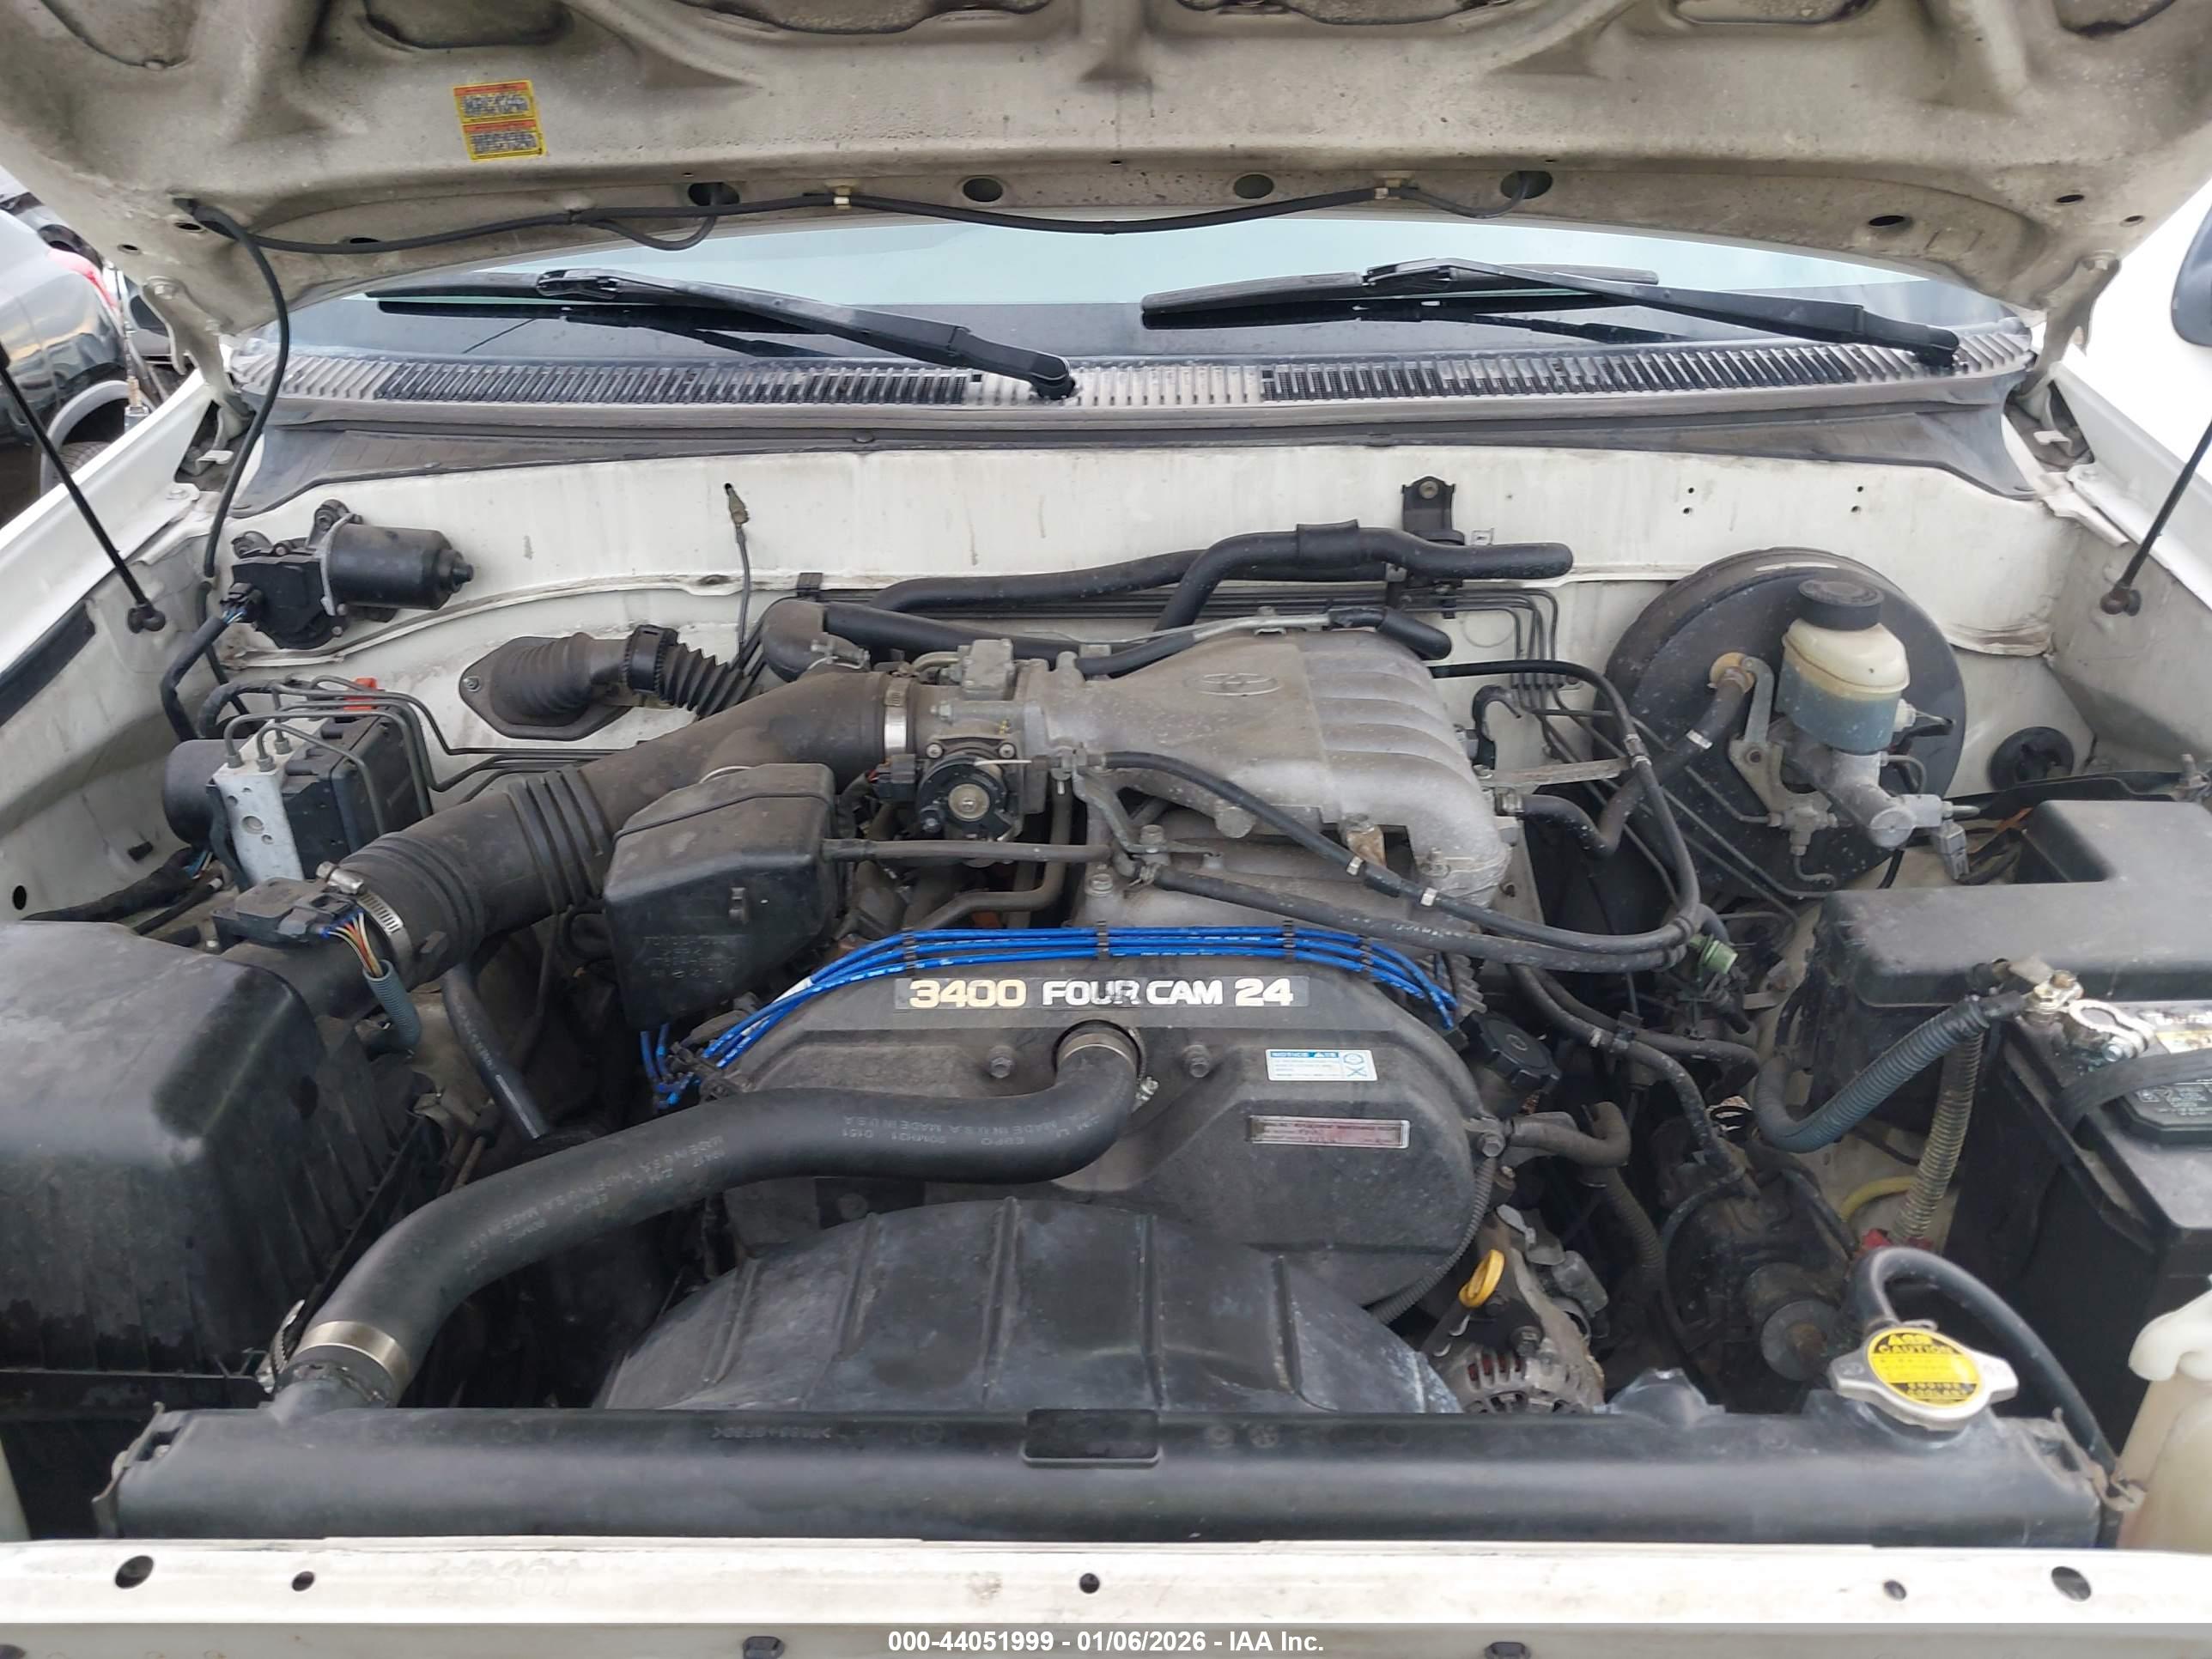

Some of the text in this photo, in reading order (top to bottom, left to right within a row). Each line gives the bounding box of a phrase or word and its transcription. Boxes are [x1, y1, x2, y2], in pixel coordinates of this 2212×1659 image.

[909, 977, 1294, 1009] 3400 FOUR CAM 24
[1878, 1344, 1954, 1354] CAUTION
